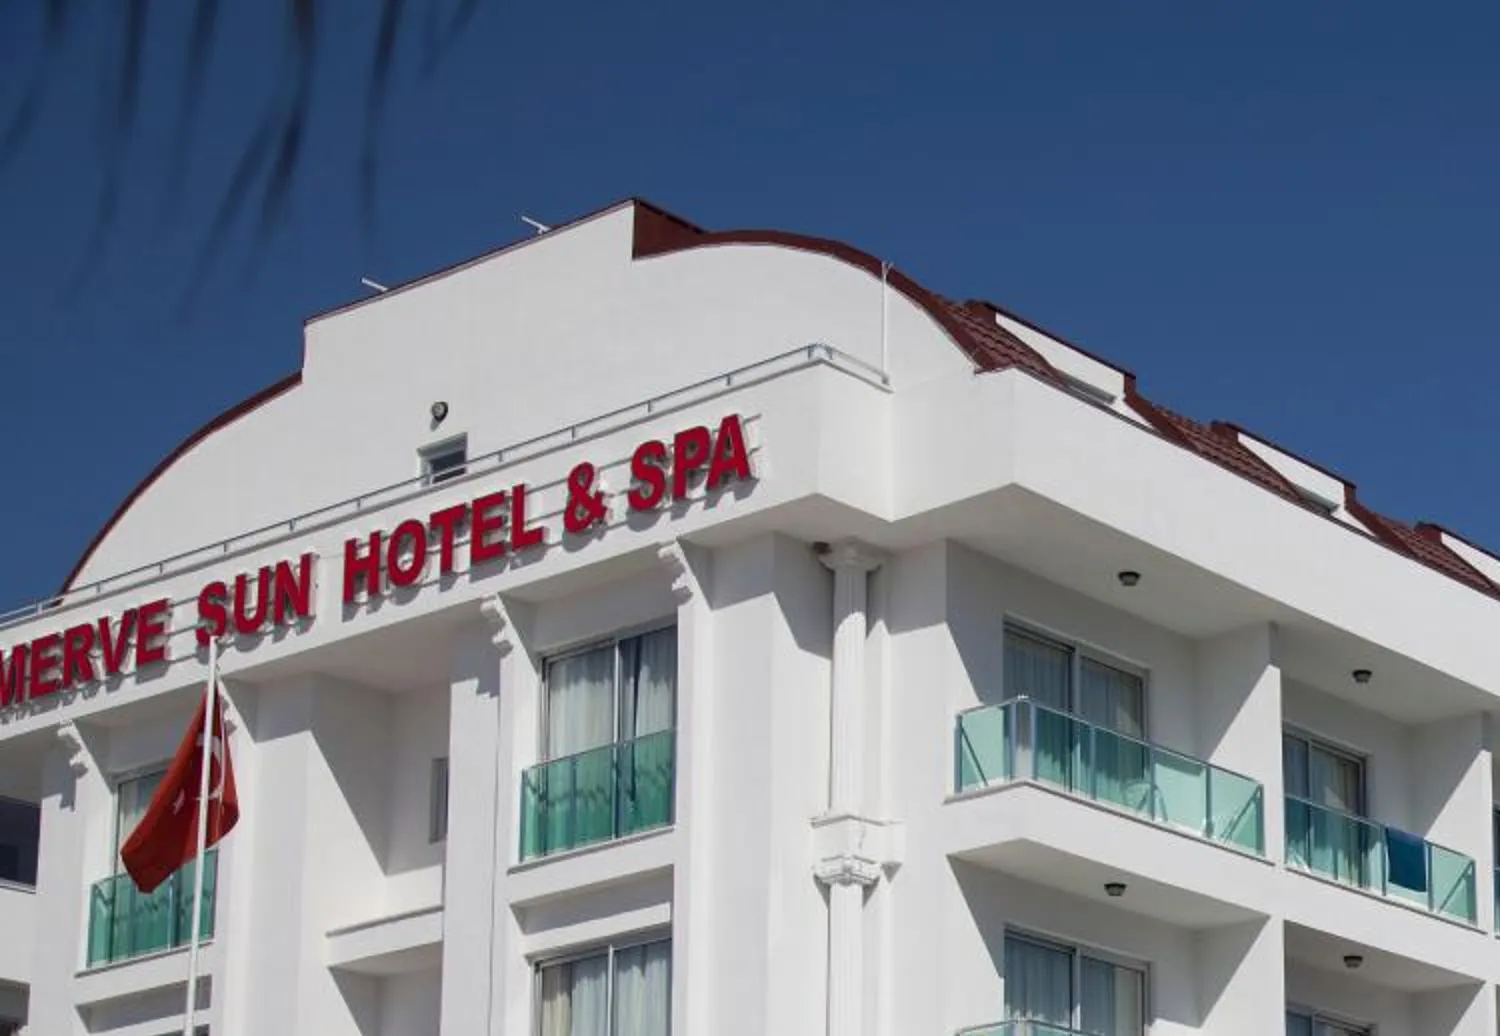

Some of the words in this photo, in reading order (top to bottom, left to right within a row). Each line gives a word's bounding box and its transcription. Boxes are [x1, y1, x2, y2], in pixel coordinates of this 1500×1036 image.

[0, 598, 169, 707] MERVE
[195, 552, 314, 645] SUN
[342, 484, 543, 602] HOTEL
[563, 462, 608, 534] &
[627, 414, 752, 511] SPA
